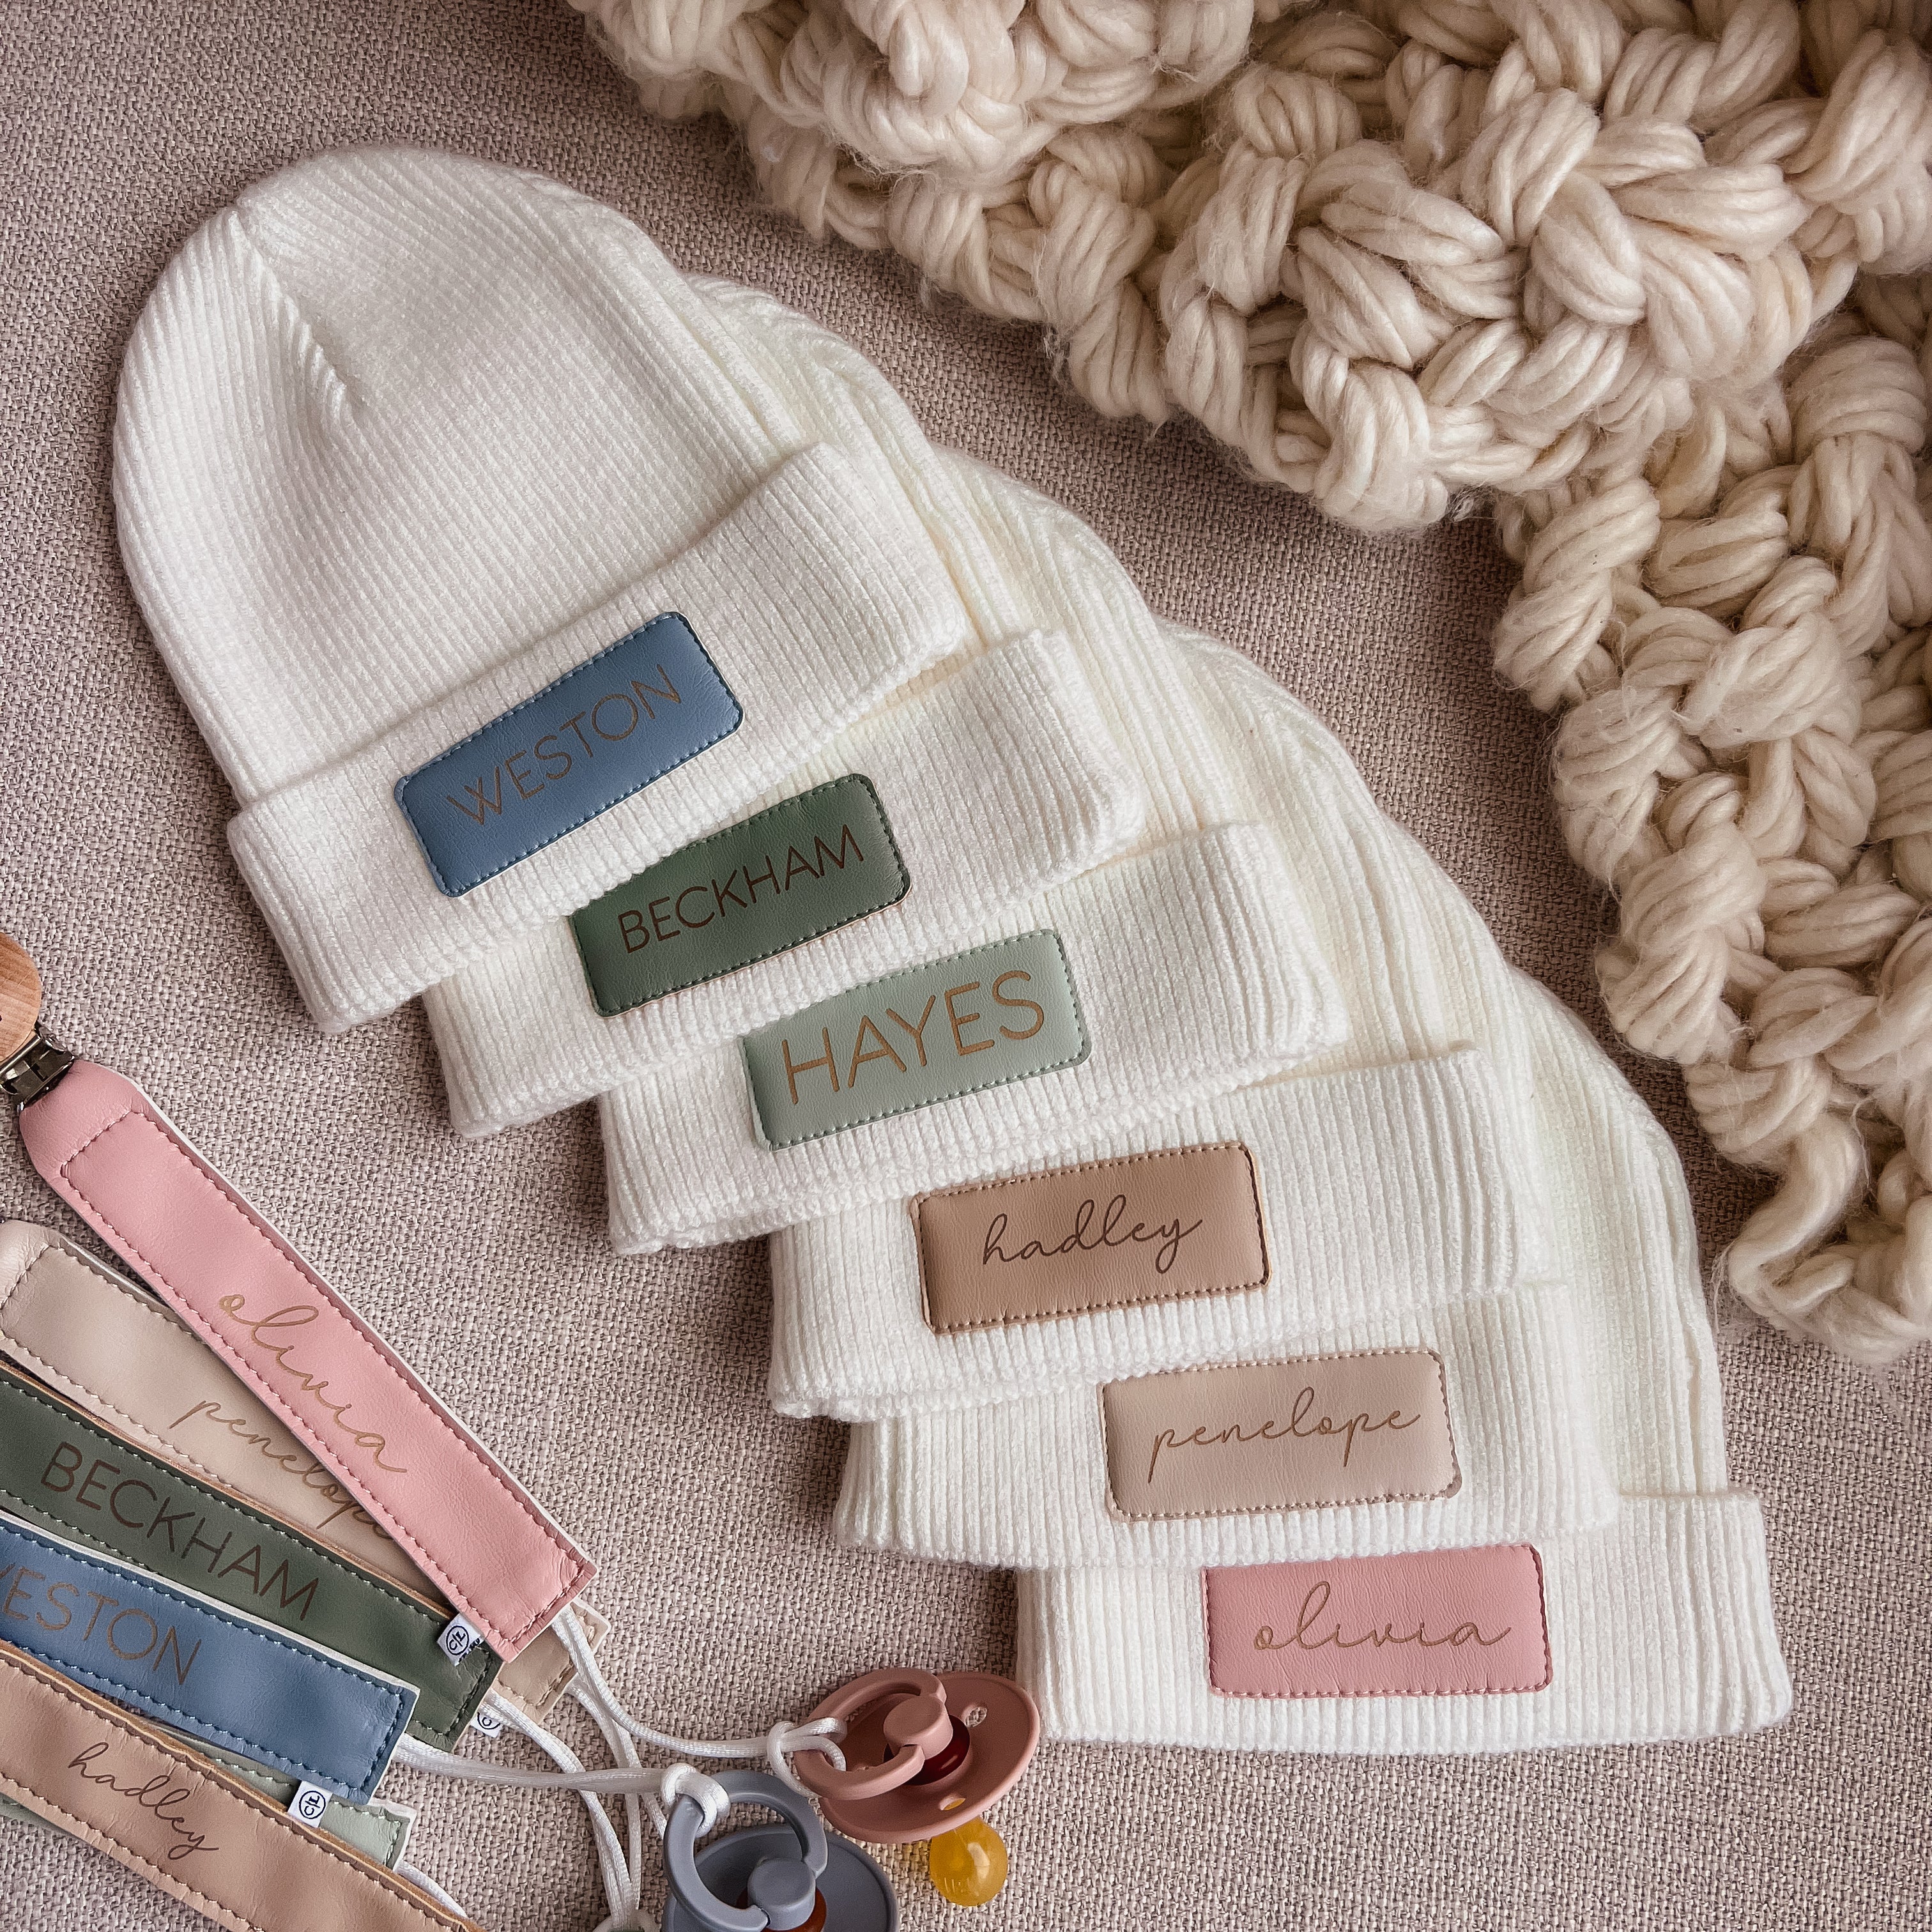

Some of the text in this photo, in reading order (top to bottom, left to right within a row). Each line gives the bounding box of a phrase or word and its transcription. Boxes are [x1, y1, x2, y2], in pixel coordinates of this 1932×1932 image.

[447, 663, 682, 826] WESTON
[618, 824, 864, 954] BECKHAM
[781, 970, 1045, 1105] HAYES
[983, 1194, 1203, 1275] hadley
[217, 1292, 408, 1473] olivia
[1147, 1386, 1421, 1483] penelope
[41, 1441, 320, 1621] BECKHAM
[0, 1563, 202, 1685] ESTON
[1253, 1580, 1512, 1651] olivia
[67, 1742, 219, 1860] hadley
